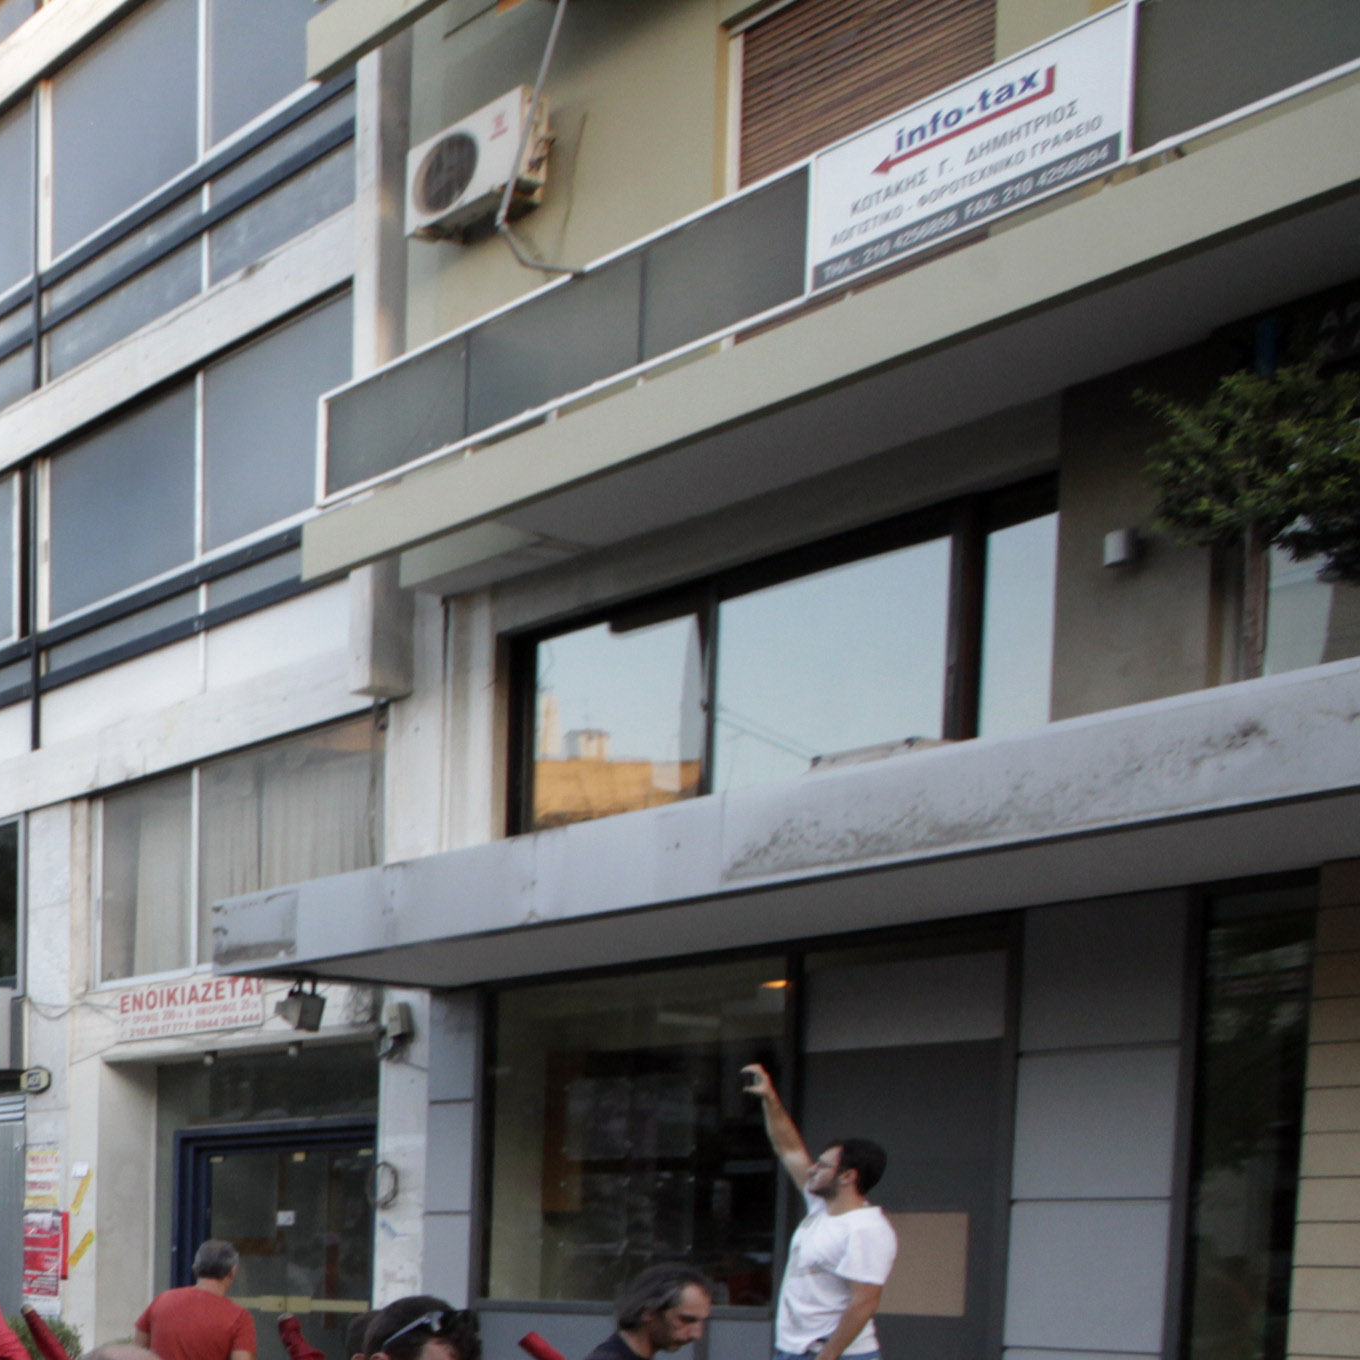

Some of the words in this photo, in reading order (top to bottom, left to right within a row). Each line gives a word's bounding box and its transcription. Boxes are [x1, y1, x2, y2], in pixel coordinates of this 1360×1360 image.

[894, 69, 1041, 153] info-tax
[964, 98, 1079, 166] ΔΗΜΗΤΡΙΟΣ
[1030, 113, 1104, 159] ΓΡΑΦΕΙΟ
